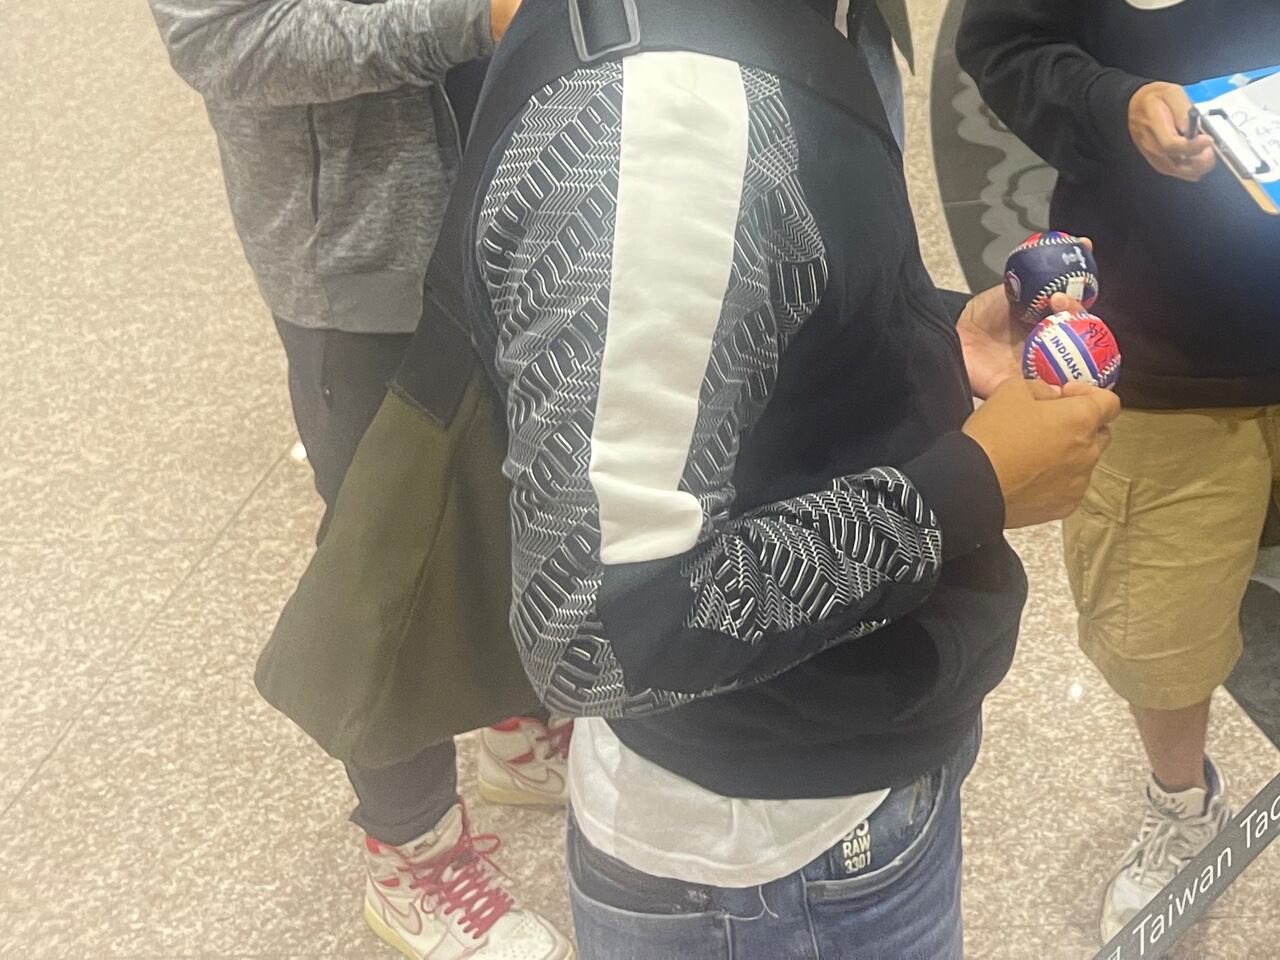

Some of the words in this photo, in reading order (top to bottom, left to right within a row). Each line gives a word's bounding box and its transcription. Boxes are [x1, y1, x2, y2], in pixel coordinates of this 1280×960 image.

[1050, 335, 1084, 381] INDIANS
[842, 834, 871, 858] RAW
[844, 850, 871, 874] 3301
[1132, 846, 1234, 956] Taiwan
